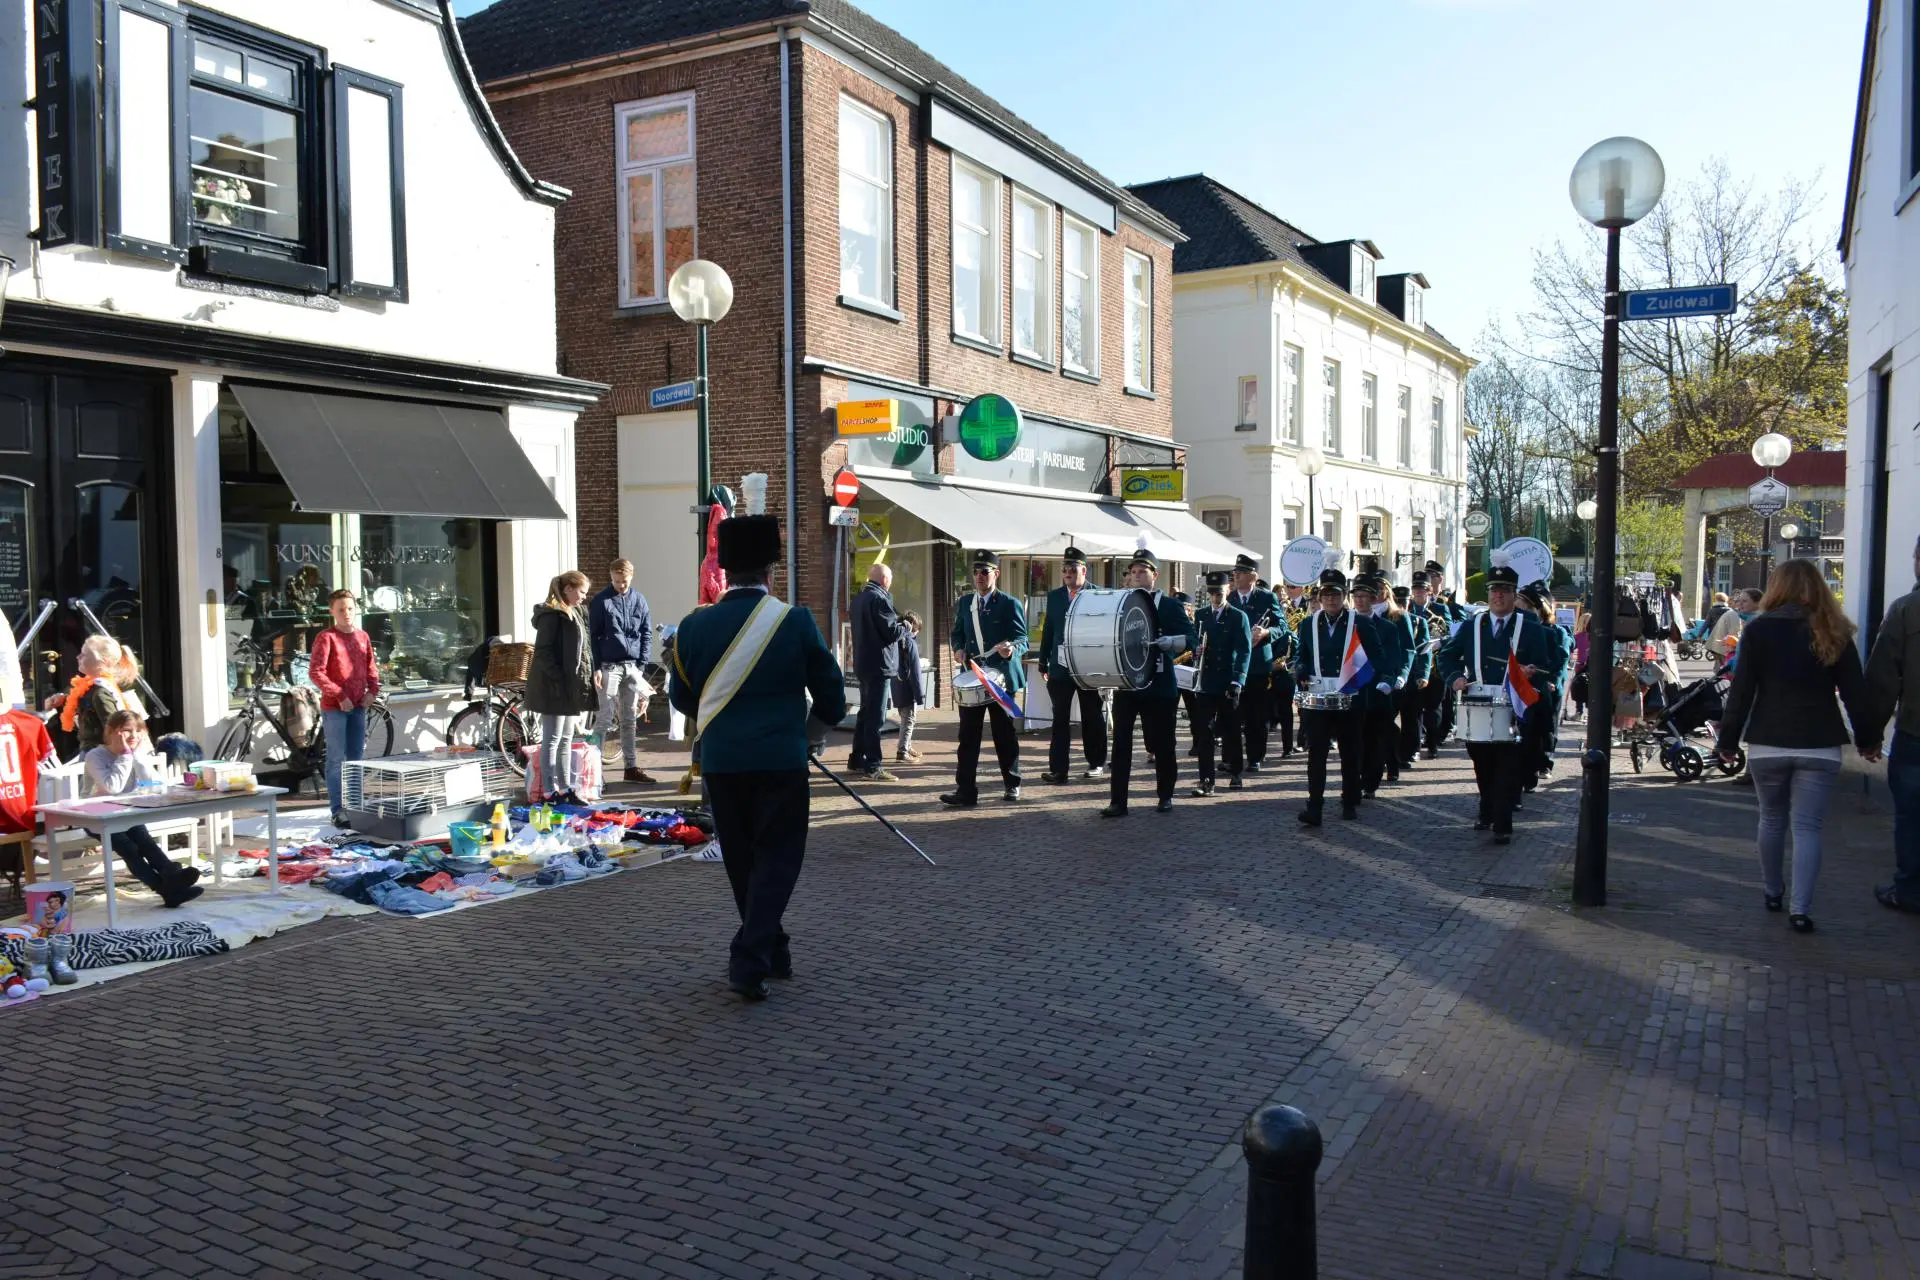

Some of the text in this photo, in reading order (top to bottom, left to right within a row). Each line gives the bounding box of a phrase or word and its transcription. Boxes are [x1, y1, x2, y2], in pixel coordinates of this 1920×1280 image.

[1646, 293, 1714, 311] Zuidwal
[655, 386, 690, 402] Noordwal
[1043, 451, 1086, 471] PARFUMERIE
[215, 547, 222, 559] 8
[275, 545, 346, 563] KUNST
[350, 546, 363, 563] &
[1511, 546, 1537, 560] ICITIA
[0, 733, 21, 783] 0
